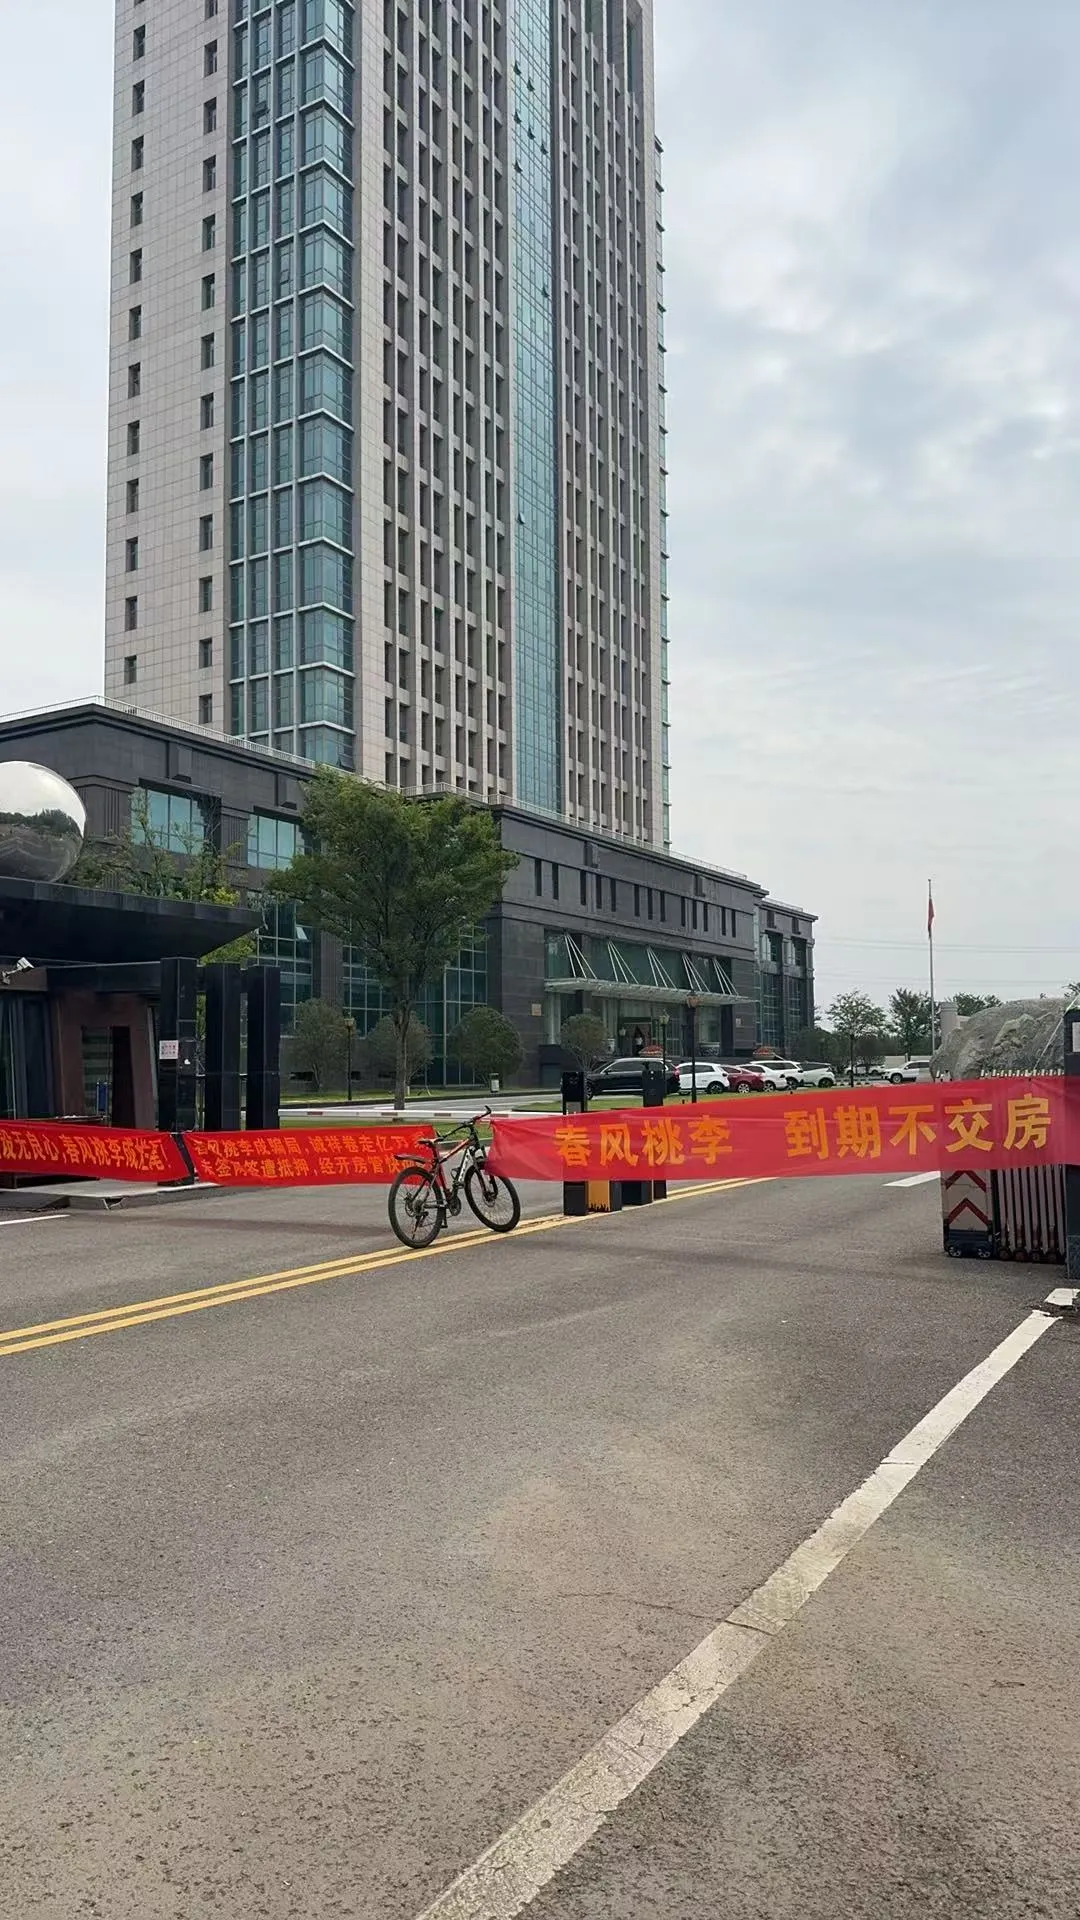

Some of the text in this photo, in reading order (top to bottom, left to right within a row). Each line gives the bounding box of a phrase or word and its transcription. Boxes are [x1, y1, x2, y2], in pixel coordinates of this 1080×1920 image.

[554, 1092, 1054, 1168] 春风桃李 到期不交房
